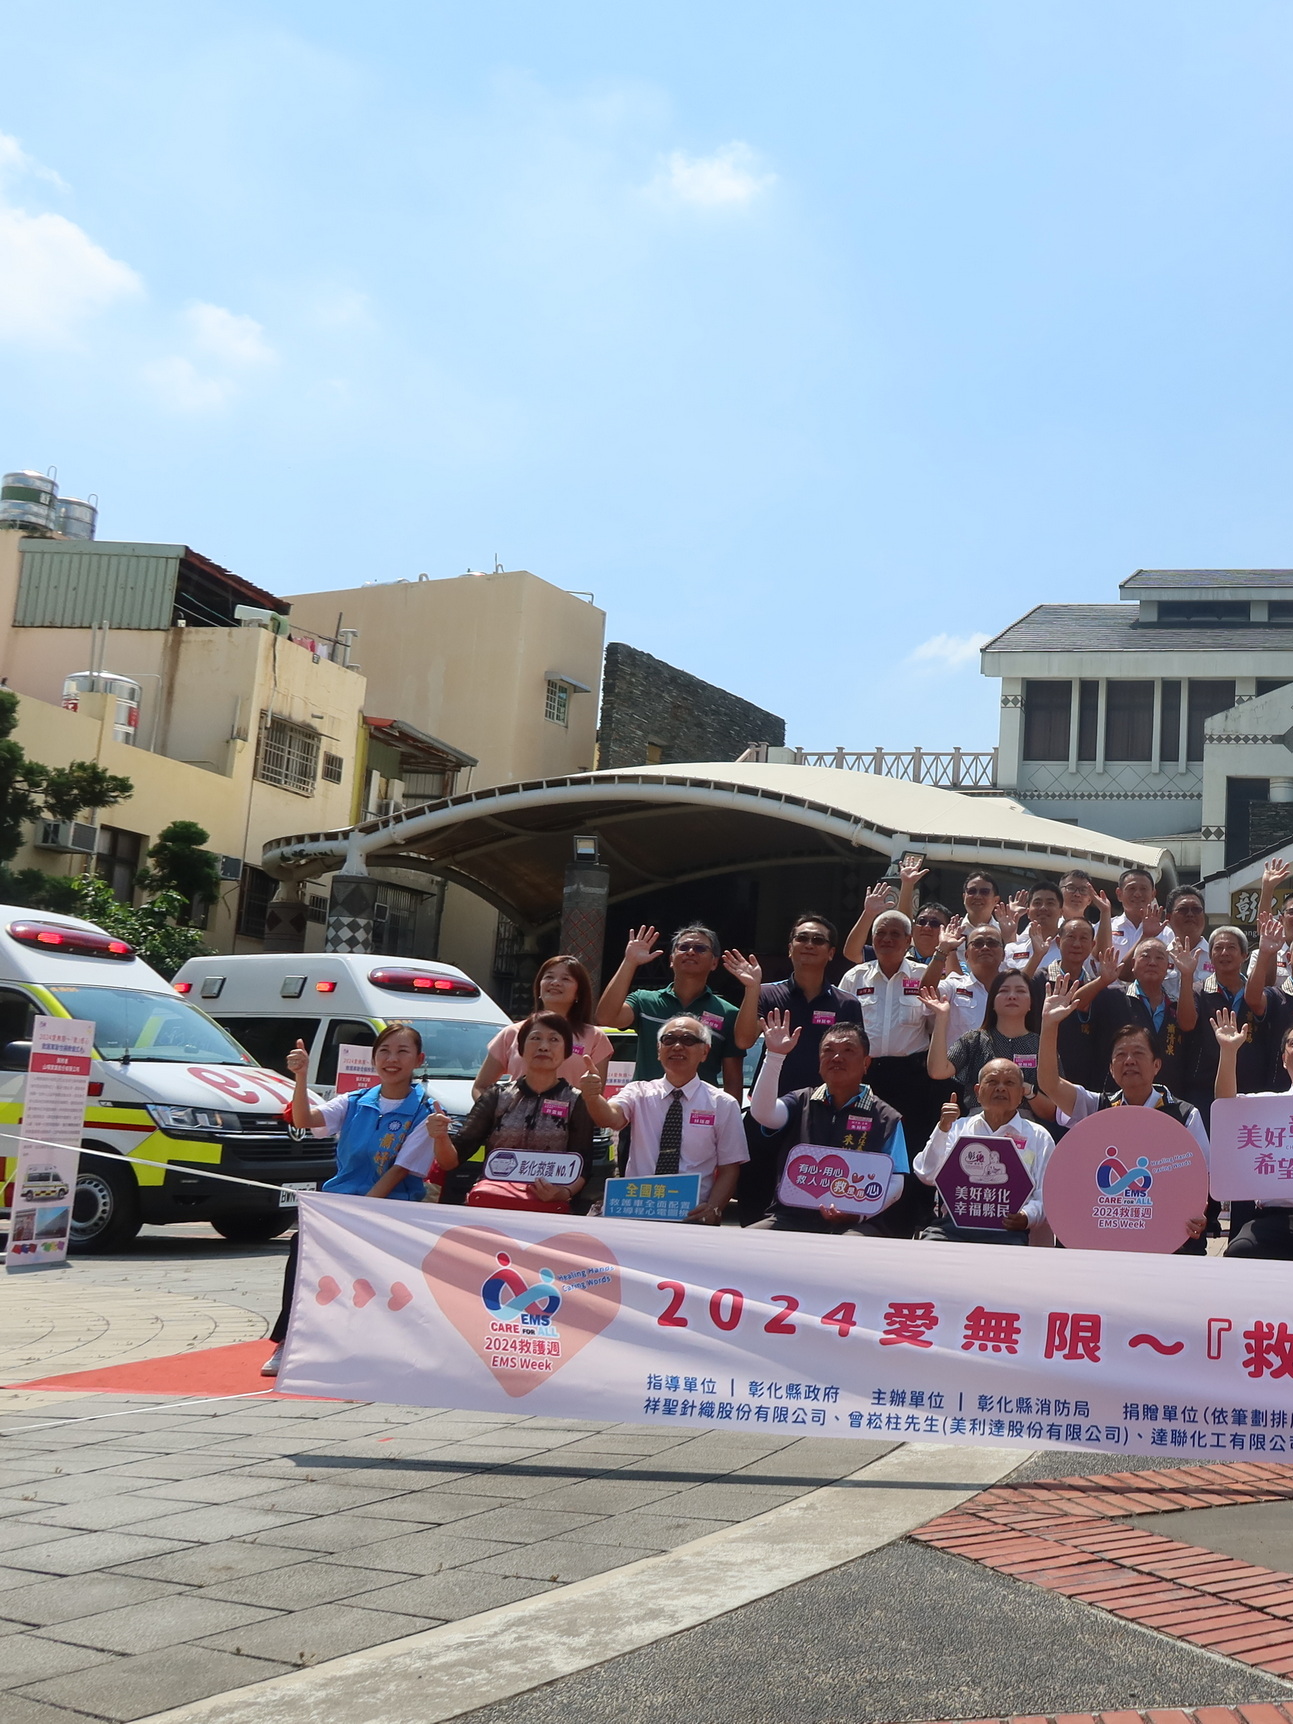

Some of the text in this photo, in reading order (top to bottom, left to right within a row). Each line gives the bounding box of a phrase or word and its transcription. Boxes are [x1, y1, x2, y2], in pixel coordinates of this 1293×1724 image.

[626, 1183, 679, 1198] 全國第一
[955, 1186, 1010, 1203] 美好彰化
[1125, 1189, 1147, 1197] EMS
[954, 1201, 1010, 1218] 幸福縣民
[1093, 1207, 1151, 1218] 2024救護週
[1099, 1219, 1145, 1228] EMS Week
[558, 1269, 587, 1281] Healing
[521, 1314, 550, 1326] EMS
[491, 1322, 520, 1334] CARE
[538, 1326, 559, 1337] ALL
[485, 1337, 560, 1356] 2024救護週
[492, 1355, 552, 1371] EMS Week
[647, 1373, 717, 1395] 指導單位
[749, 1380, 840, 1404] 彰化縣政府
[871, 1388, 945, 1410] 主辦單位
[977, 1394, 1090, 1418] 彰化縣消防局
